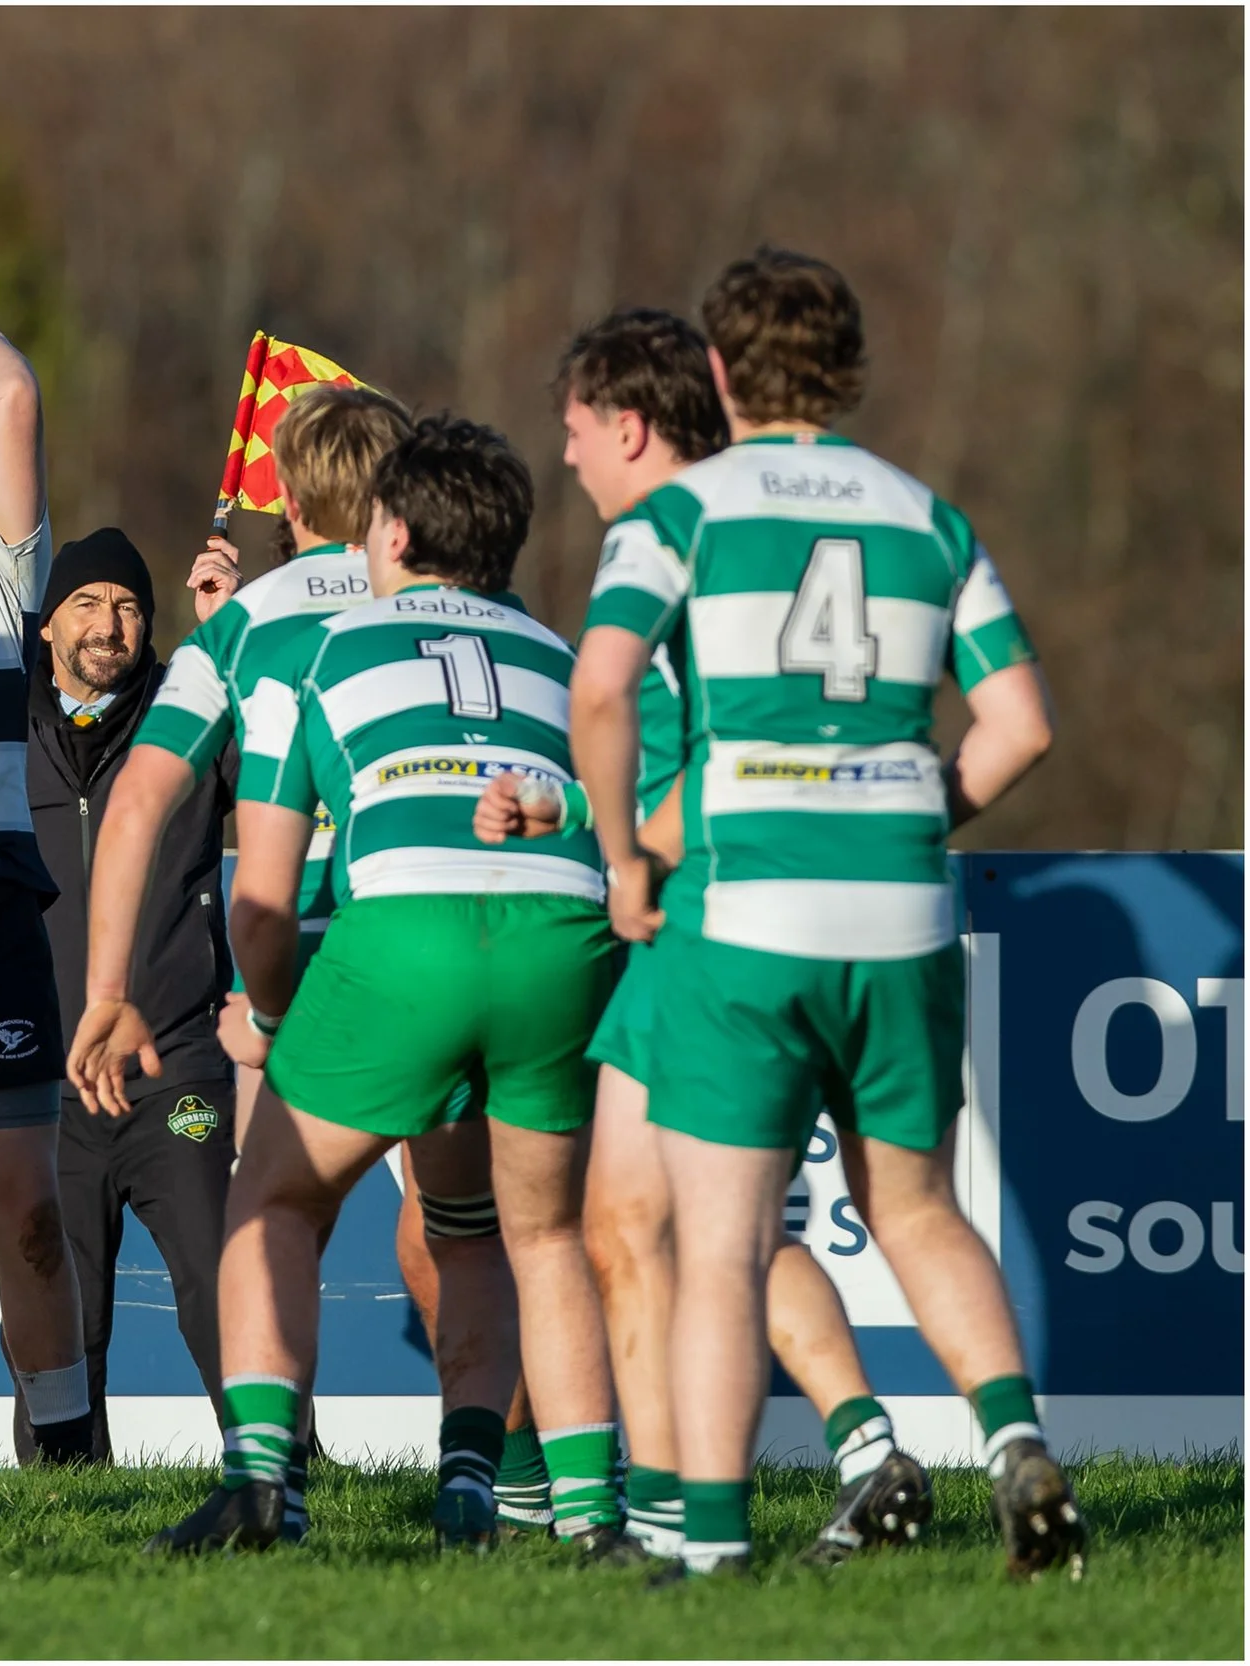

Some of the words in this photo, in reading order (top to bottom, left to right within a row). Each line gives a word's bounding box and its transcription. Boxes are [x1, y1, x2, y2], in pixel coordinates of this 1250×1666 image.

[307, 574, 368, 597] Bab
[395, 597, 506, 620] Babbé
[778, 535, 879, 702] 4
[415, 632, 501, 721] 1
[171, 1112, 215, 1130] GUERNSEY
